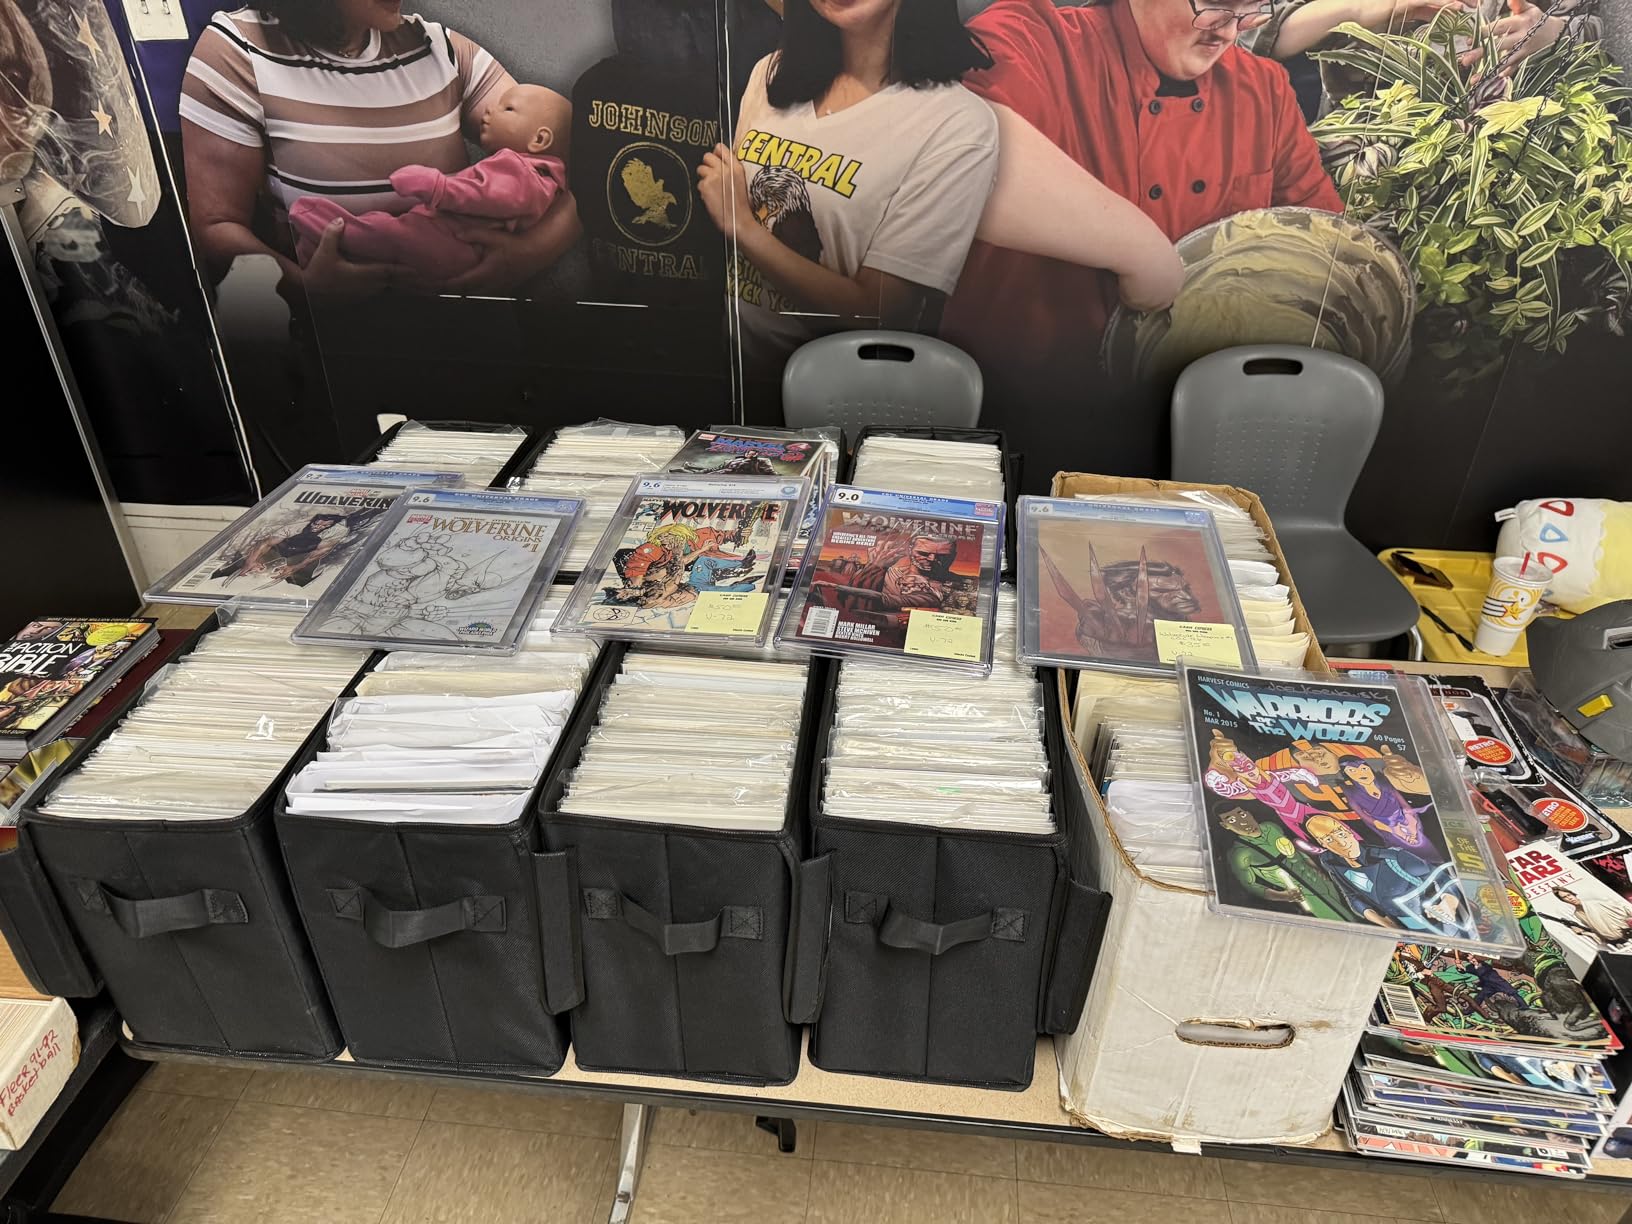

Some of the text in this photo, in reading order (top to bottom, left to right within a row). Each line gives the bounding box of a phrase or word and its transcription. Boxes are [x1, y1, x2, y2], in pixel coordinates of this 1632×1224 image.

[589, 100, 717, 147] JOHNSON
[737, 129, 863, 199] CENTRAL
[643, 481, 661, 489] 9.6
[412, 495, 431, 504] 9.6
[838, 492, 860, 501] 9.0
[432, 516, 547, 538] WOLVERINE
[842, 511, 977, 536] WOLVERINE
[493, 535, 542, 543] ORIGINS
[522, 542, 539, 553] #1
[11, 642, 83, 655] ACTION
[1198, 675, 1250, 689] HARVEST COMICS
[1198, 683, 1391, 728] WARRIORS
[1203, 709, 1217, 719] No.
[1204, 717, 1239, 729] MAR 2015
[1278, 719, 1373, 743] WORD
[1373, 734, 1405, 745] 60 Pages
[1397, 743, 1407, 751] $7
[1467, 740, 1496, 752] RETRO
